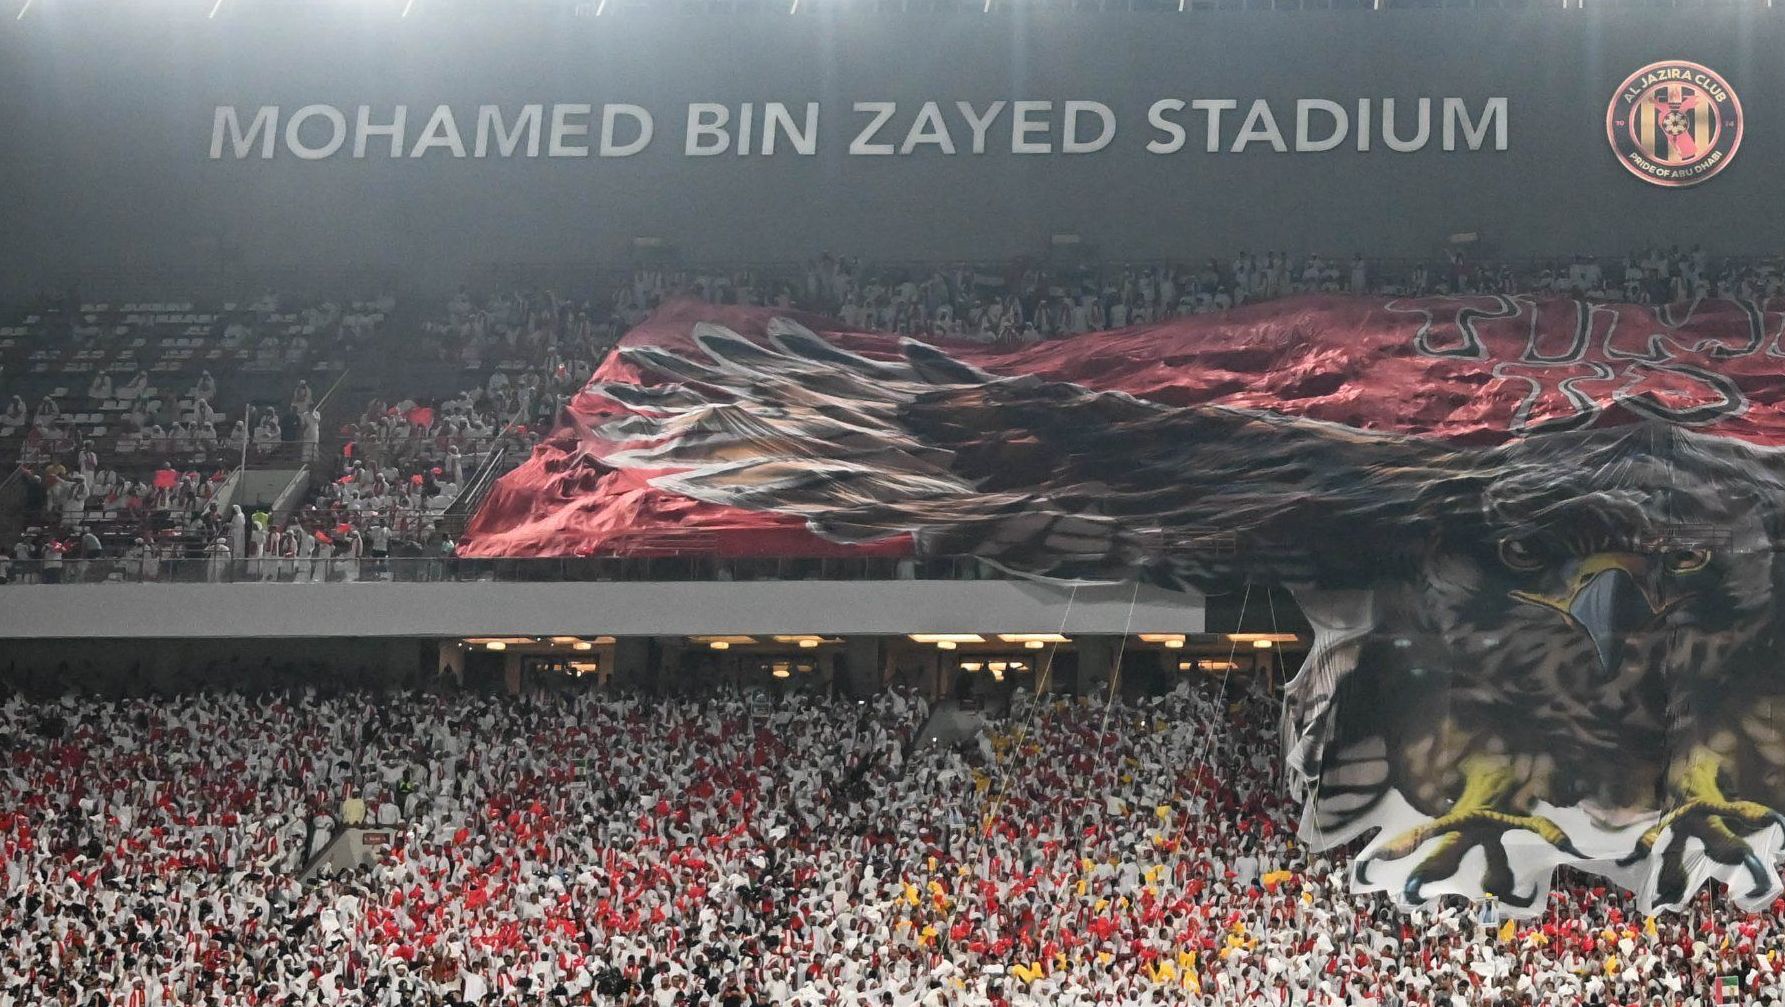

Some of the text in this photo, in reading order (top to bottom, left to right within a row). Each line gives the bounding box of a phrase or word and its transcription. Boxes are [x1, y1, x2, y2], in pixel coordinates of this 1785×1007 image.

[1624, 68, 1728, 103] AL JAZIRA CLUB
[207, 96, 1510, 160] MOHAMED BIN ZAYED STADIUM
[1629, 150, 1724, 178] PRIDE OF ABU DHABI
